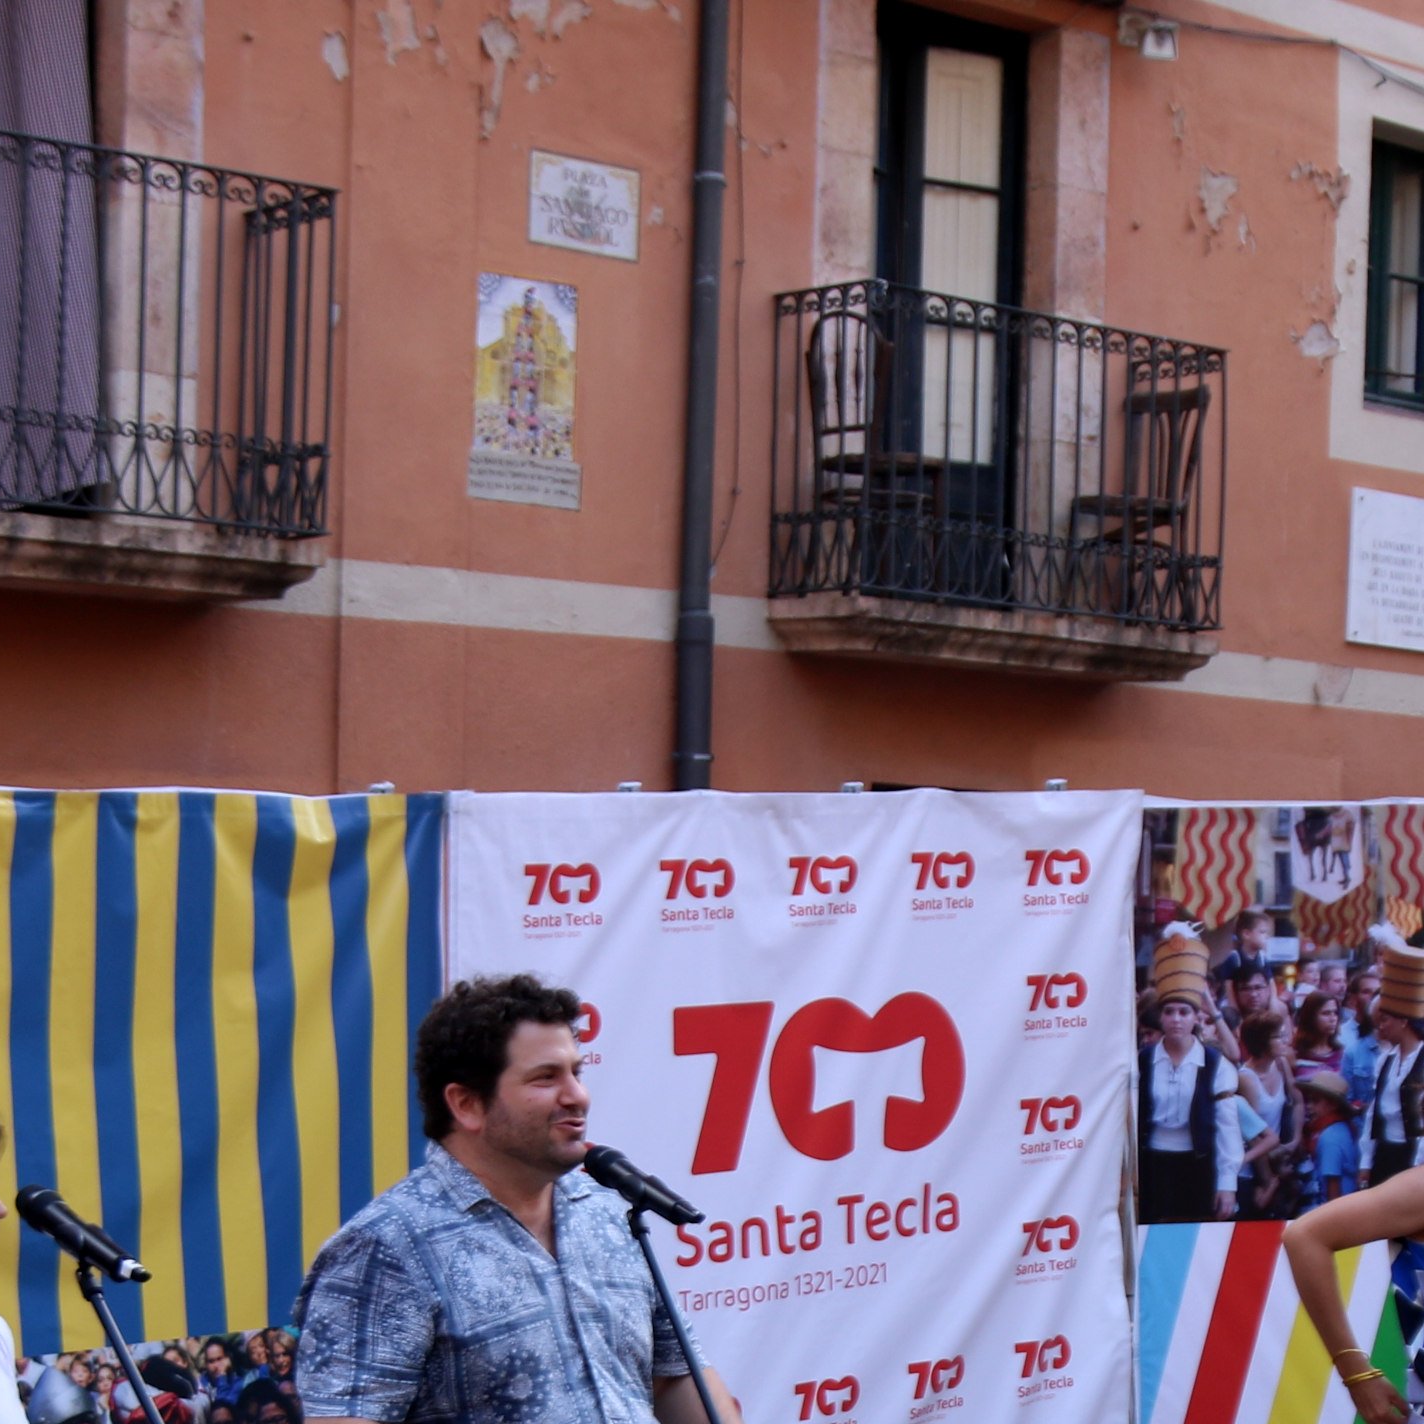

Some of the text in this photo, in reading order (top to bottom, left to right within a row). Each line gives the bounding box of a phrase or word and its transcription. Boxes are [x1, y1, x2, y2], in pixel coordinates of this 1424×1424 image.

[912, 895, 974, 911] Santa Tecla
[1023, 891, 1090, 907] Santa Tecla
[660, 906, 735, 922] Santa Tecla
[788, 901, 858, 917] Santa Tecla
[522, 911, 604, 929] Santa Tecla
[1024, 1014, 1088, 1032] Santa Tecla
[1019, 1137, 1084, 1156] Santa Tecla
[676, 1183, 960, 1267] Santa Tecla
[1015, 1257, 1078, 1276] Santa Tecla
[678, 1262, 888, 1312] Tarragona 1321-2021
[1018, 1375, 1074, 1399] Santa Tecla
[909, 1404, 935, 1421] Santa
[936, 1395, 964, 1410] Tecla
